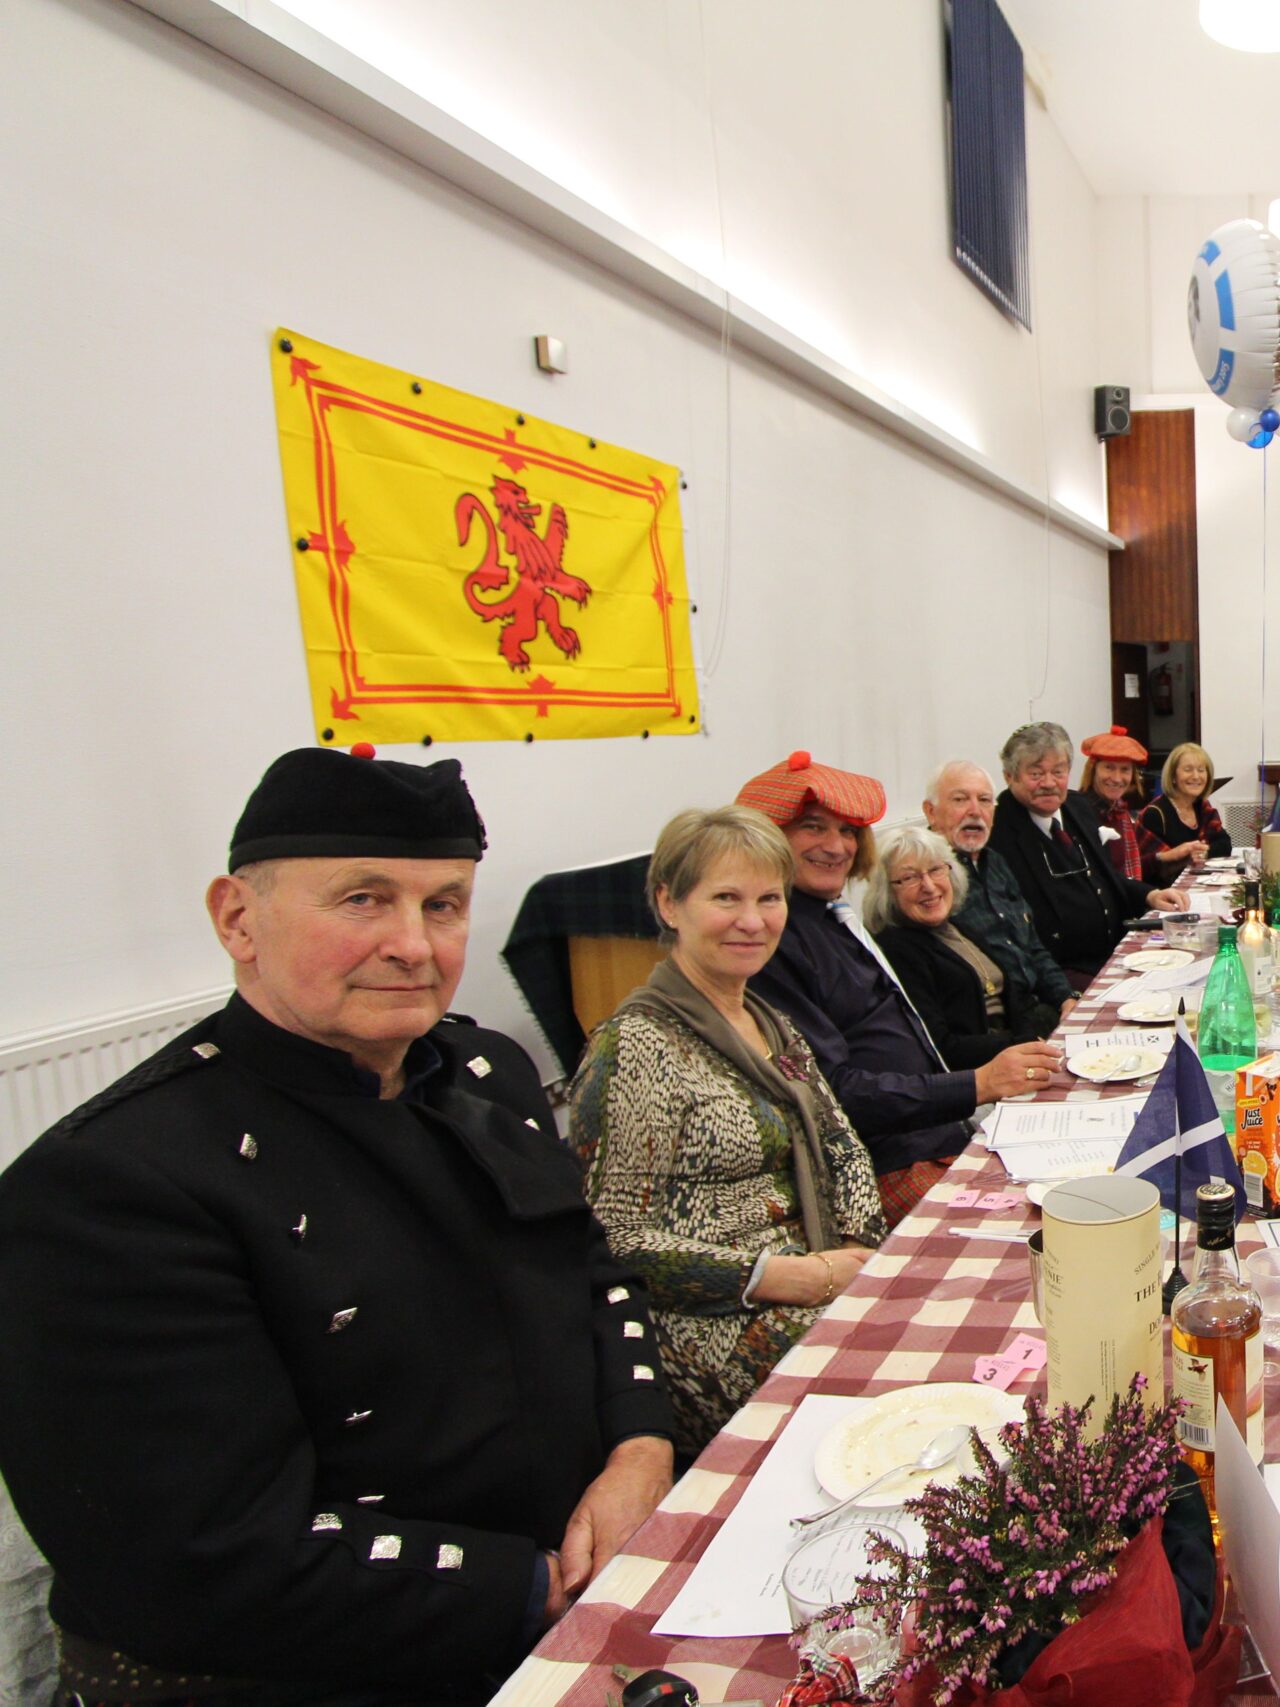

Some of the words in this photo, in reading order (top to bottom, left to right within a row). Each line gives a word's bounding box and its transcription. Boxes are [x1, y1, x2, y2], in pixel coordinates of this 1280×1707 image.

[1240, 1117, 1264, 1130] Juice
[1134, 1249, 1156, 1276] SINGLE
[1134, 1280, 1157, 1302] THE
[1023, 1348, 1033, 1360] 1
[983, 1367, 998, 1381] 3
